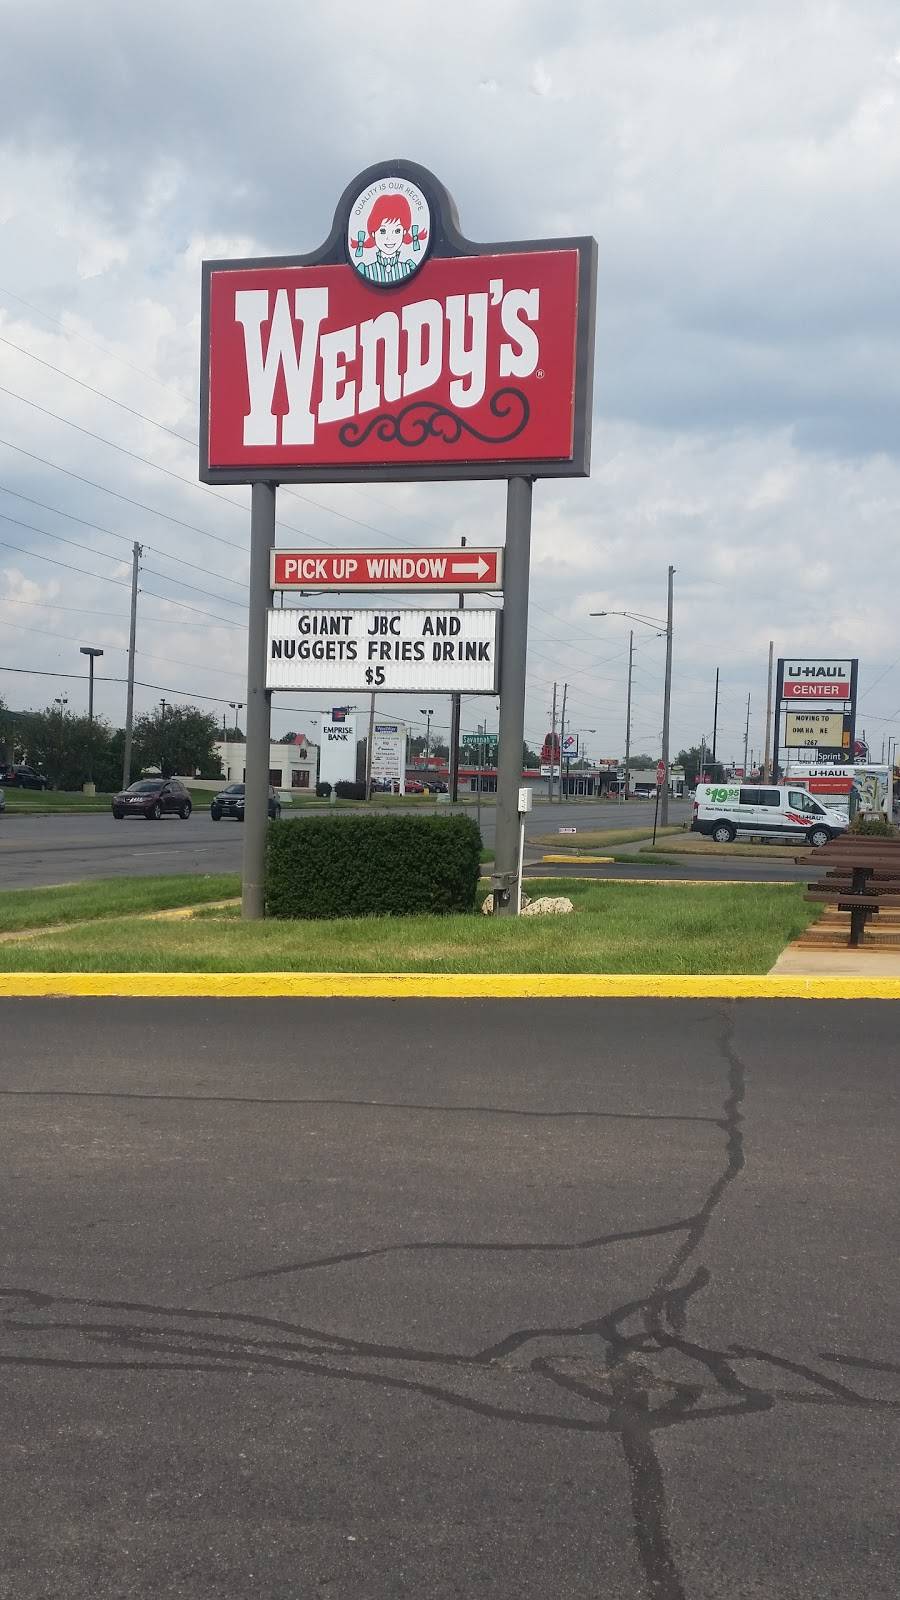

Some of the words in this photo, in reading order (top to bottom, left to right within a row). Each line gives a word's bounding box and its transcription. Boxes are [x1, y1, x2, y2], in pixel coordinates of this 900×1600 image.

[355, 187, 377, 216] QUALITY
[379, 183, 387, 191] IS
[388, 182, 404, 191] OUR
[405, 186, 424, 212] RECIPE
[285, 559, 328, 579] PICK
[332, 559, 358, 579] UP
[367, 558, 448, 579] WINDOW
[298, 615, 353, 636] GIANT
[368, 616, 401, 636] JBC
[422, 616, 461, 636] AND
[271, 640, 358, 660] NUGGETS
[368, 641, 425, 661] FRIES
[432, 642, 491, 661] DRINK
[365, 666, 385, 685] $5
[788, 666, 846, 677] U-HAUL
[793, 685, 839, 694] CENTER
[323, 726, 353, 734] EMPRISE
[328, 734, 348, 742] BANK
[818, 752, 841, 761] Sprint
